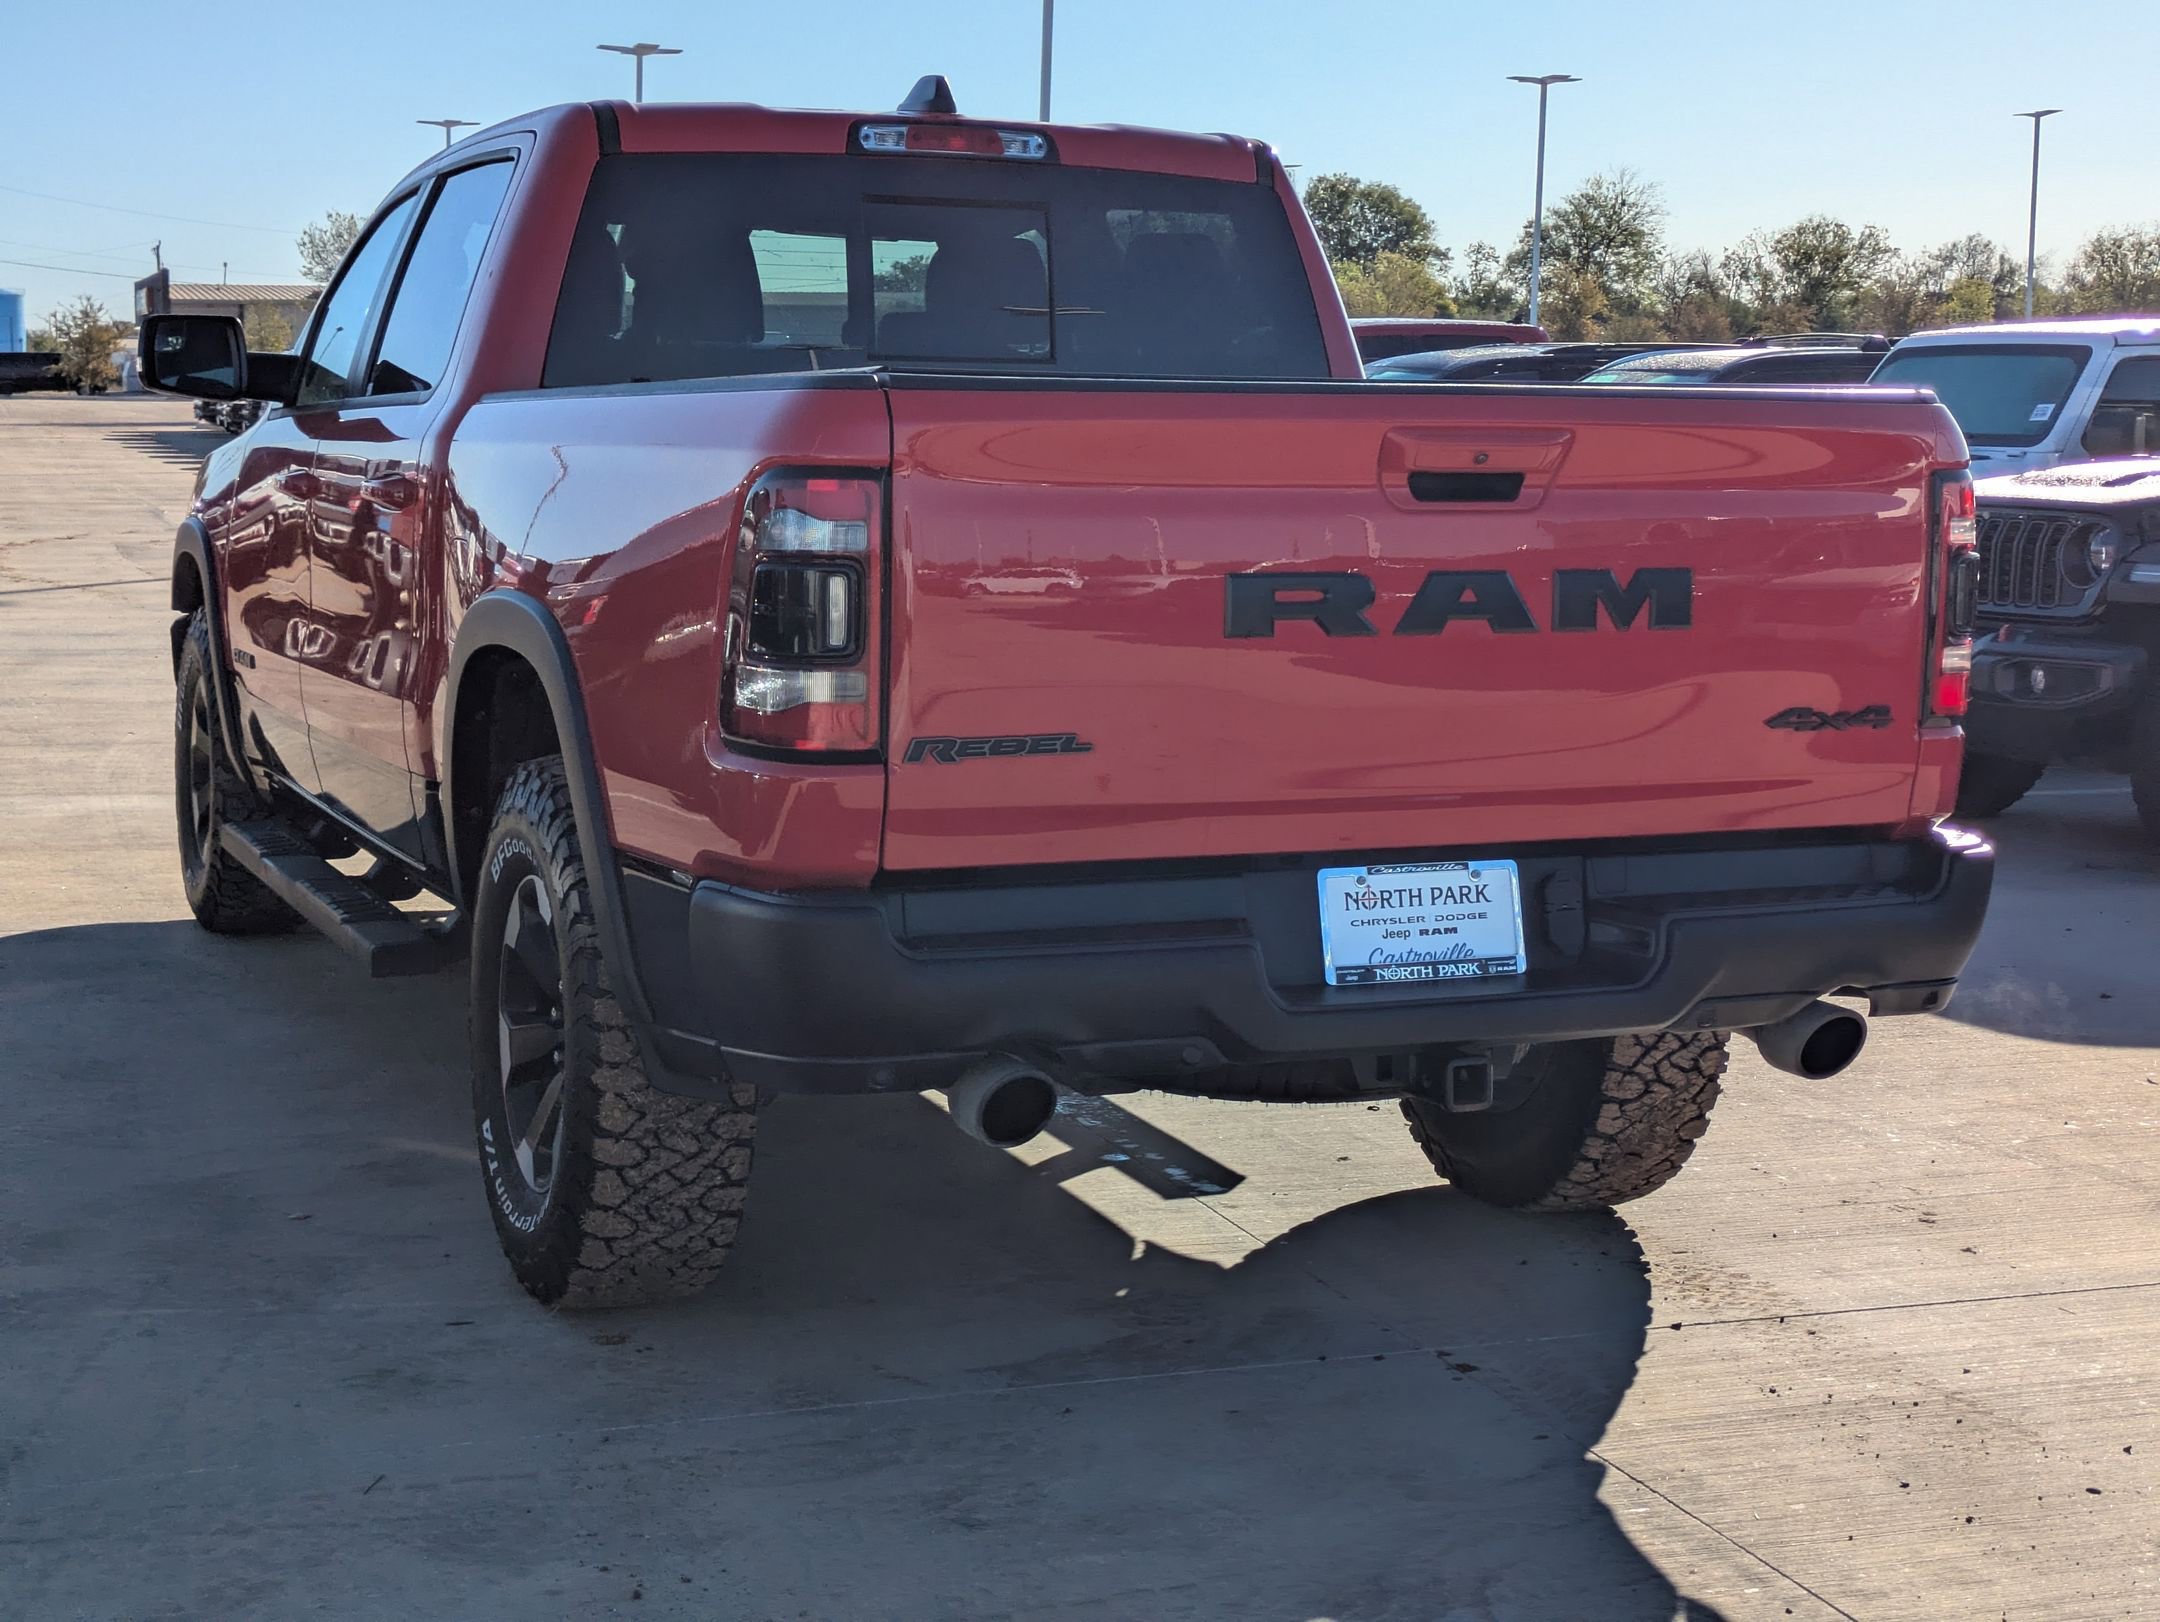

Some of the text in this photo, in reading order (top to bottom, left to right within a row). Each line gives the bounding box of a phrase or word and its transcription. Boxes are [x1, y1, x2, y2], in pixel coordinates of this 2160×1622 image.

[1224, 568, 1693, 638] RAM
[902, 732, 1094, 764] REBEL
[1370, 863, 1465, 874] Castroville
[1344, 884, 1492, 912] NORTH PARK
[1350, 911, 1489, 927] CHRYSLER DODGE
[1382, 926, 1459, 941] Jeep RAM
[1368, 942, 1474, 964] Castroville
[1374, 965, 1434, 981] NORTH
[1436, 962, 1483, 977] PARK
